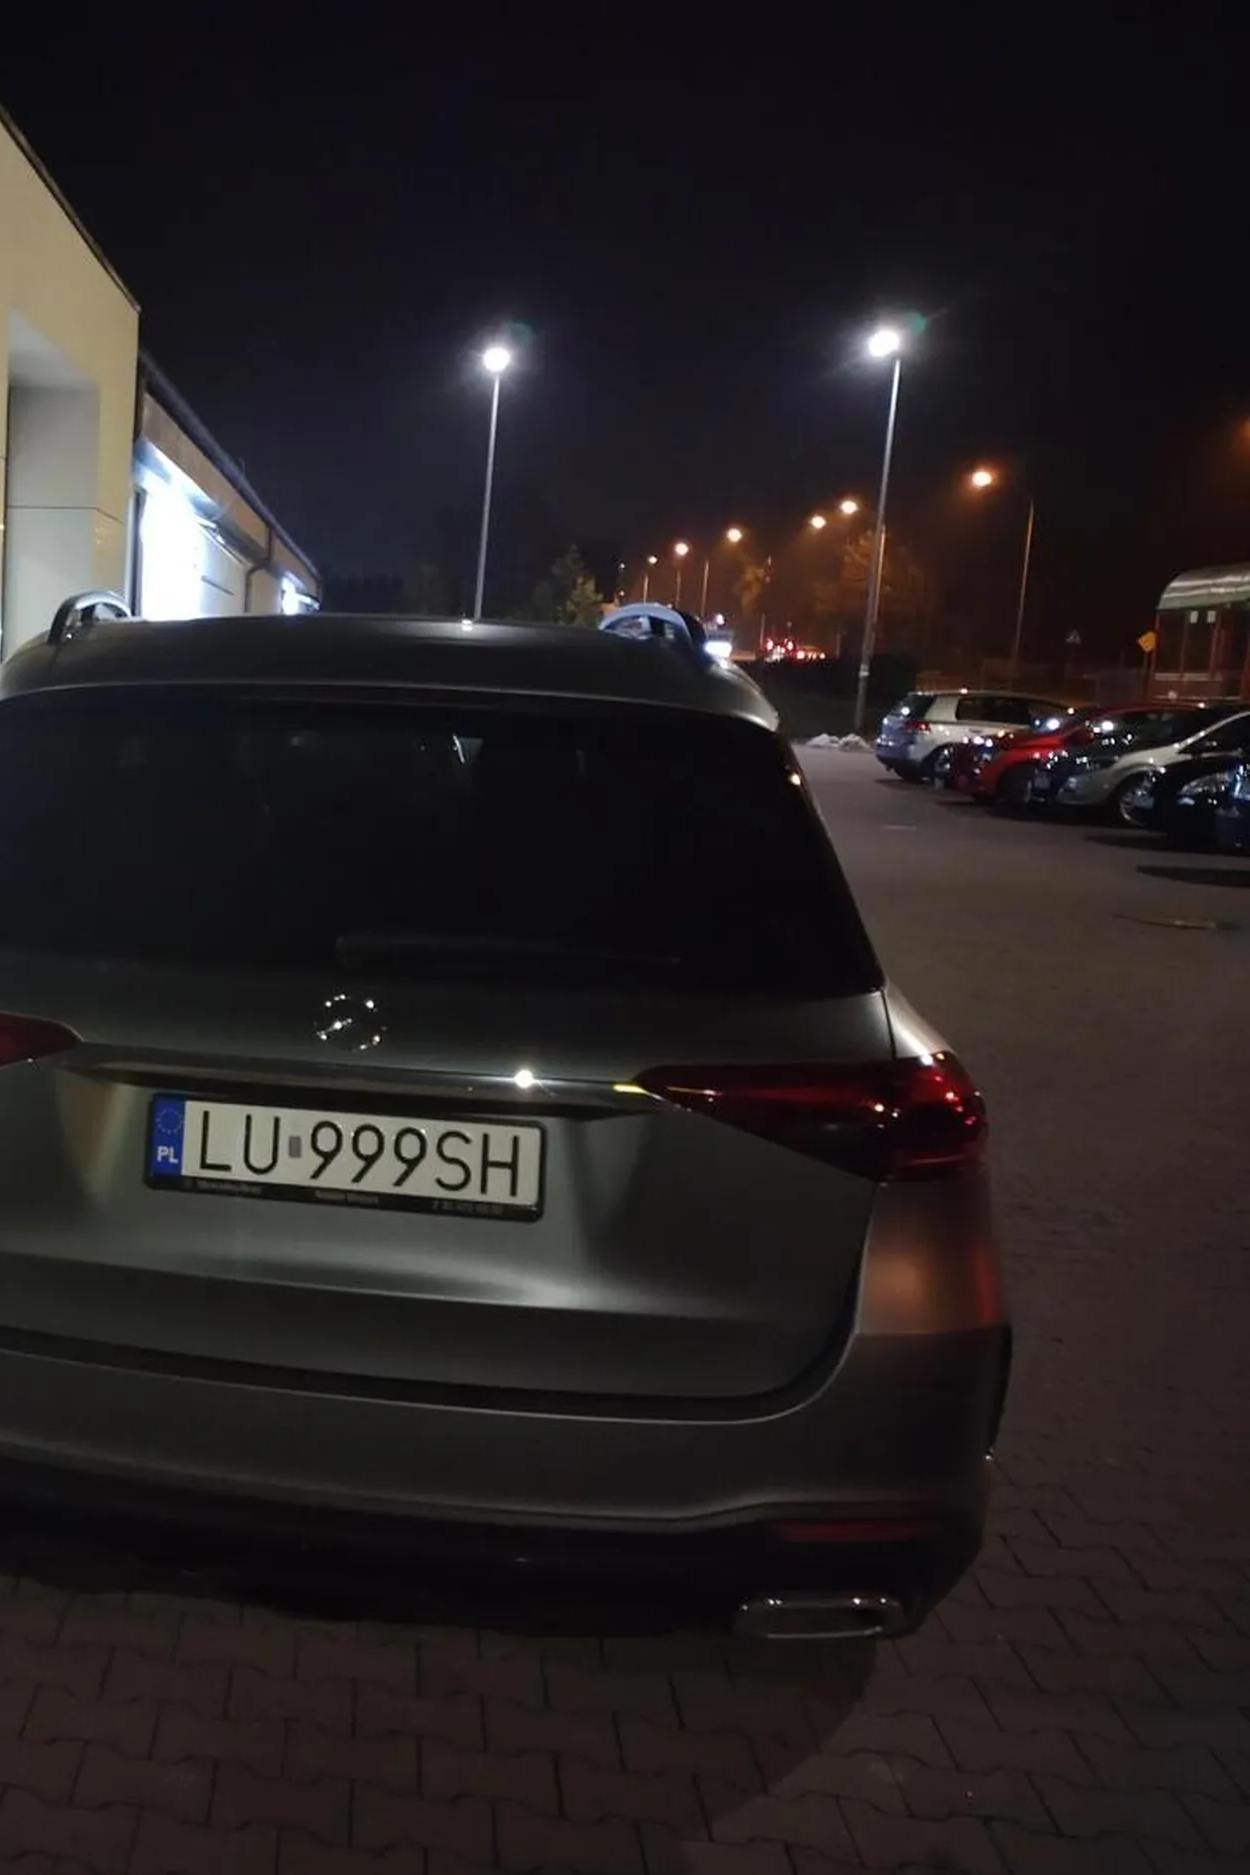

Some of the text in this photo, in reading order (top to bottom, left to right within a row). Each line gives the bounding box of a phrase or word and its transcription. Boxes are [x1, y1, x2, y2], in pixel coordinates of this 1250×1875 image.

[157, 1145, 178, 1164] PL
[199, 1110, 520, 1197] LU 999SH
